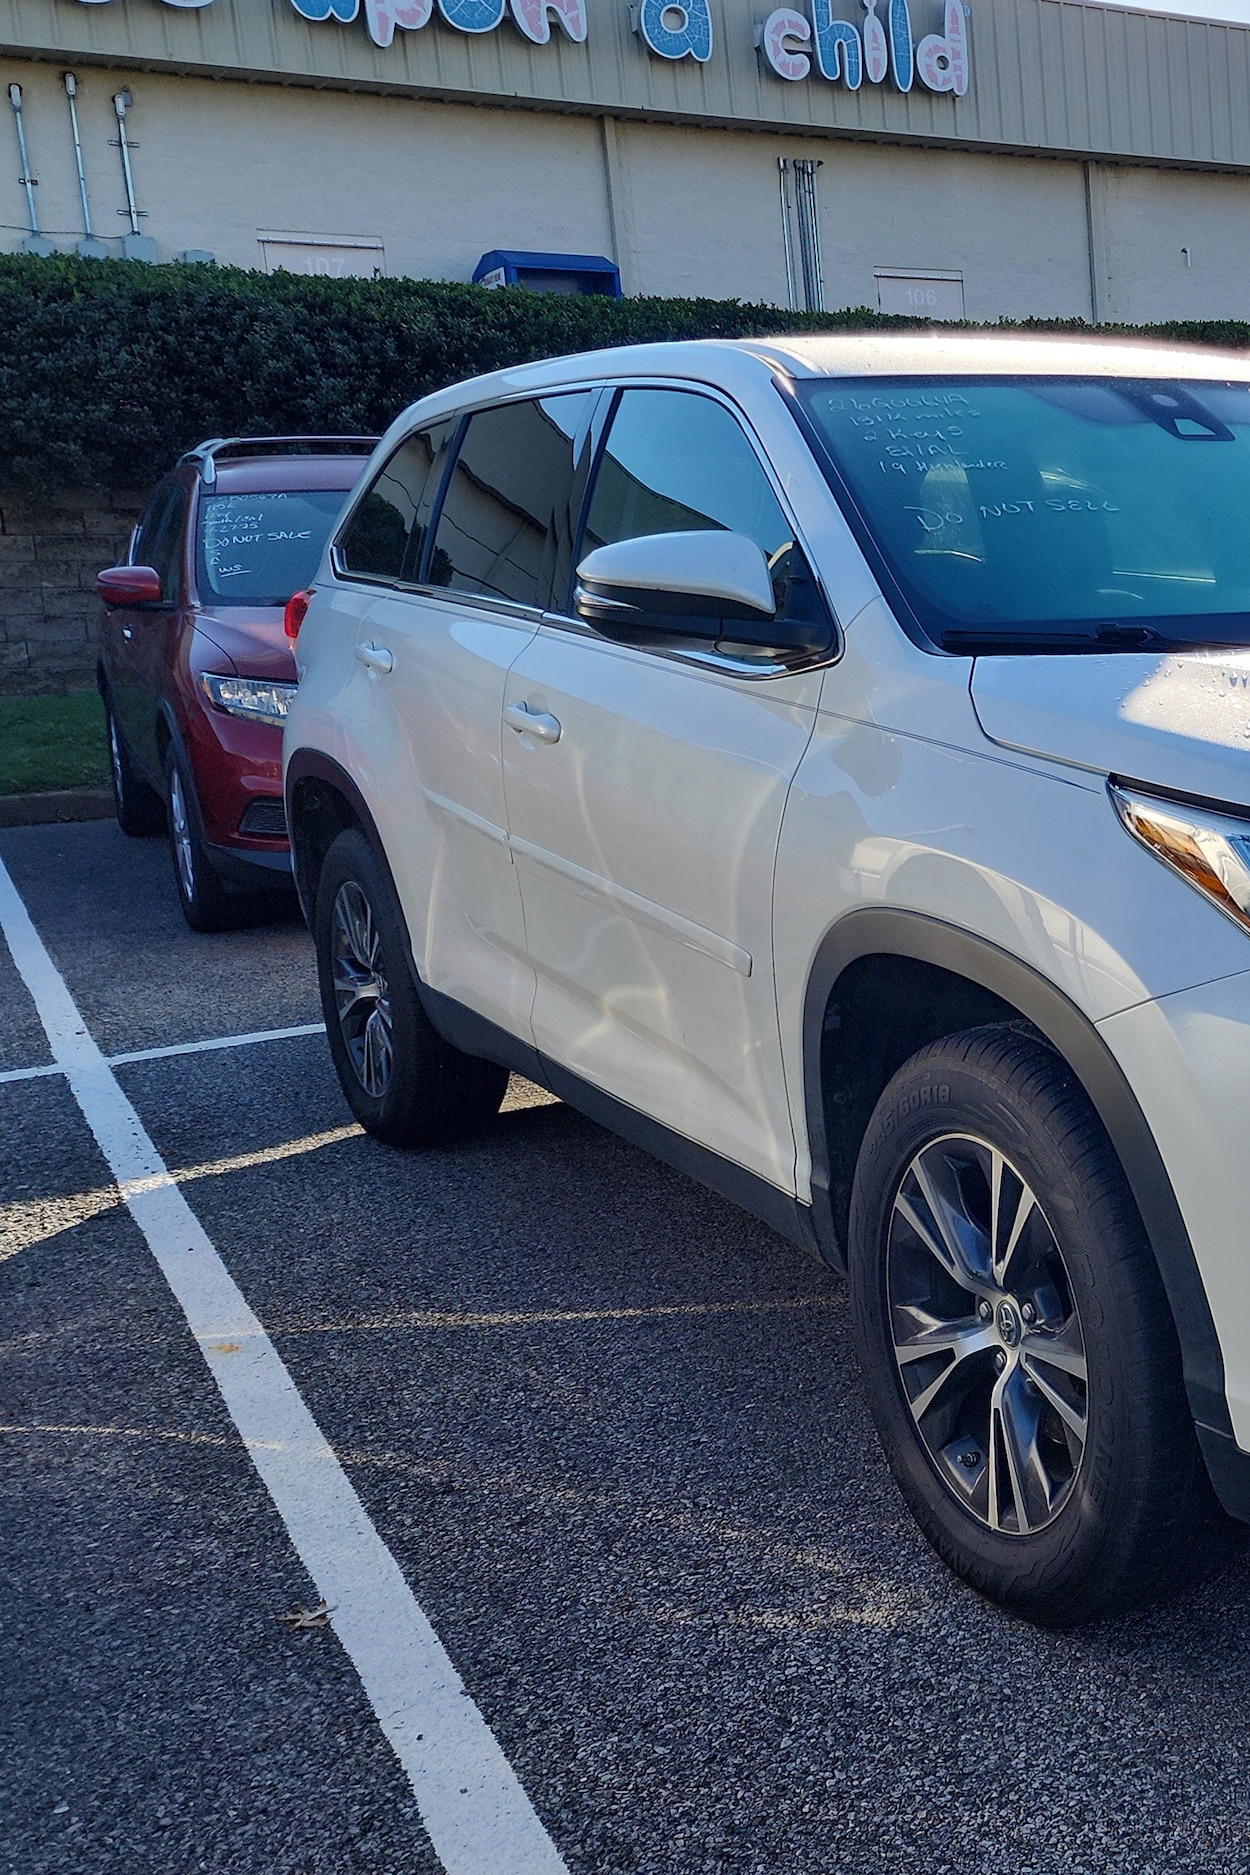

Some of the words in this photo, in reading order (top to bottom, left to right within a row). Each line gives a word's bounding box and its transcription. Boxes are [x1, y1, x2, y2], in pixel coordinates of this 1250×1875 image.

[641, 0, 713, 62] a
[764, 0, 968, 96] child
[301, 256, 345, 277] 107
[905, 288, 937, 307] 106
[979, 500, 1034, 518] NOT
[1045, 500, 1120, 511] SELL
[203, 538, 230, 549] DO
[232, 534, 263, 544] NOT
[267, 530, 312, 541] SALE
